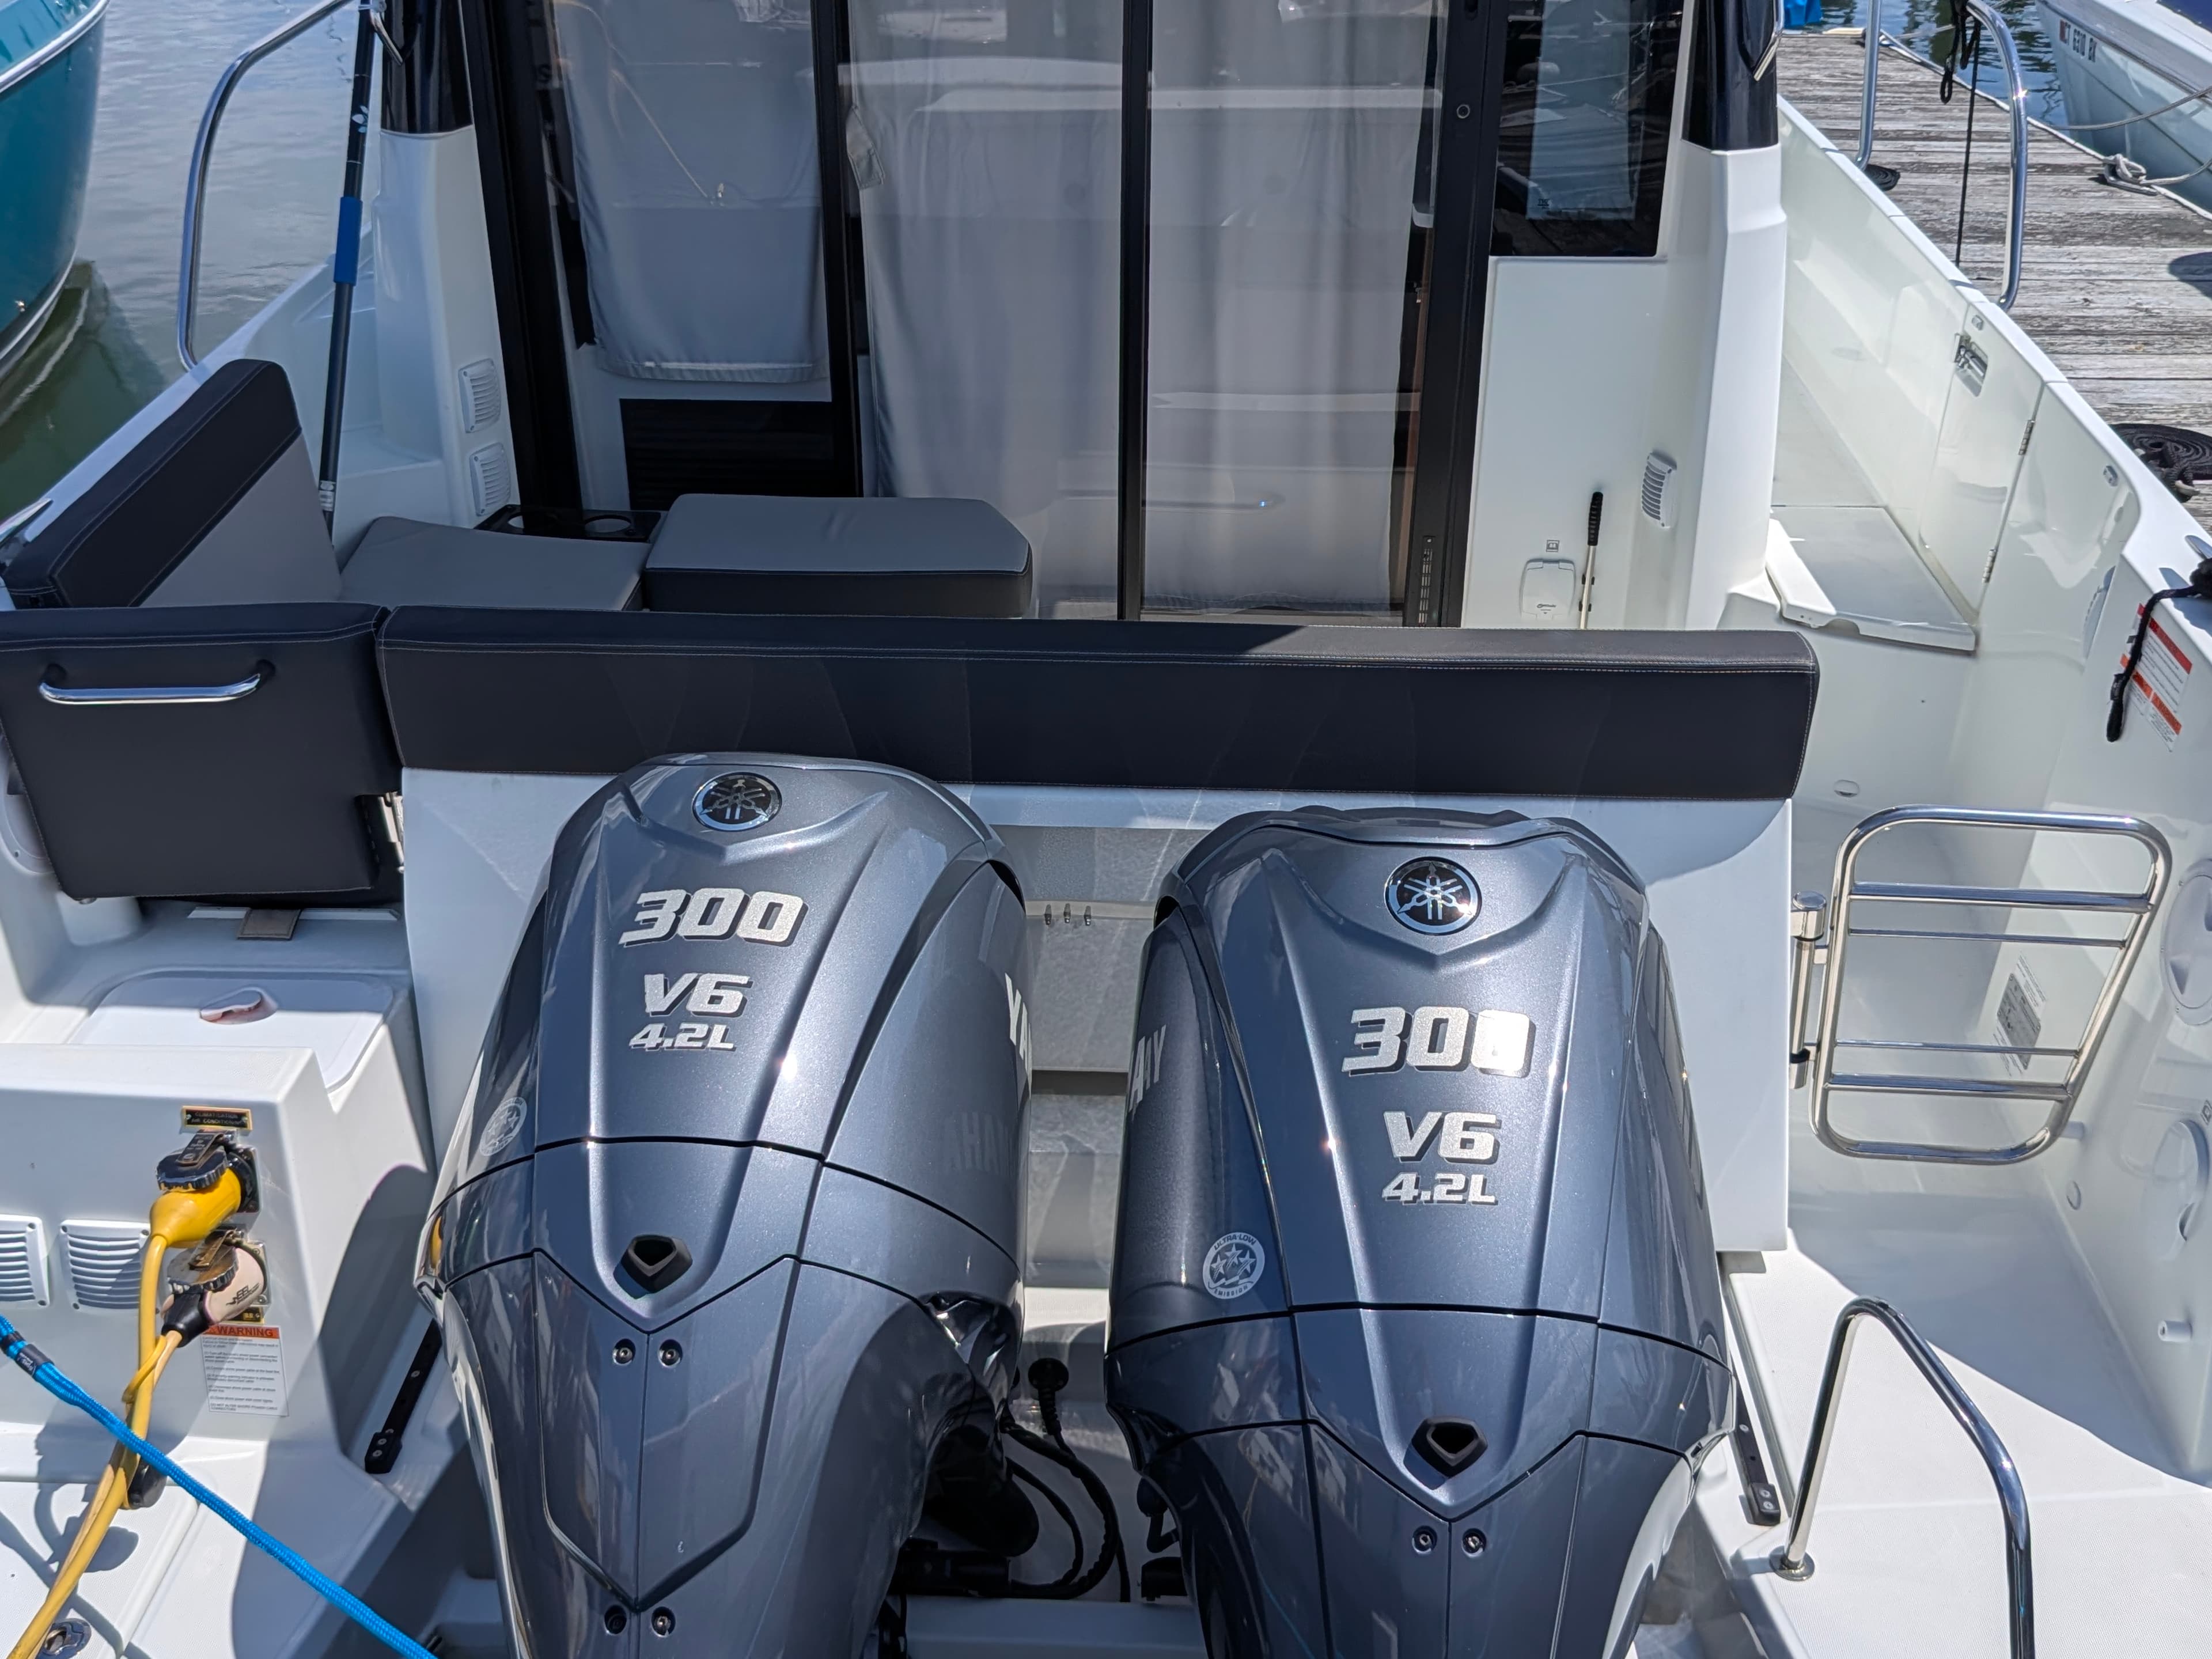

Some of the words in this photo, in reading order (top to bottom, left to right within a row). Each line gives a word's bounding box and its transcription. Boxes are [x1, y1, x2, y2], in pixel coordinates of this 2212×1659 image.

[619, 888, 809, 948] 300
[644, 972, 753, 1018] V6
[628, 1022, 737, 1051] 4.2L
[1383, 1111, 1502, 1165] V6
[1382, 1172, 1498, 1206] 4.2L
[218, 1325, 274, 1337] WARNING
